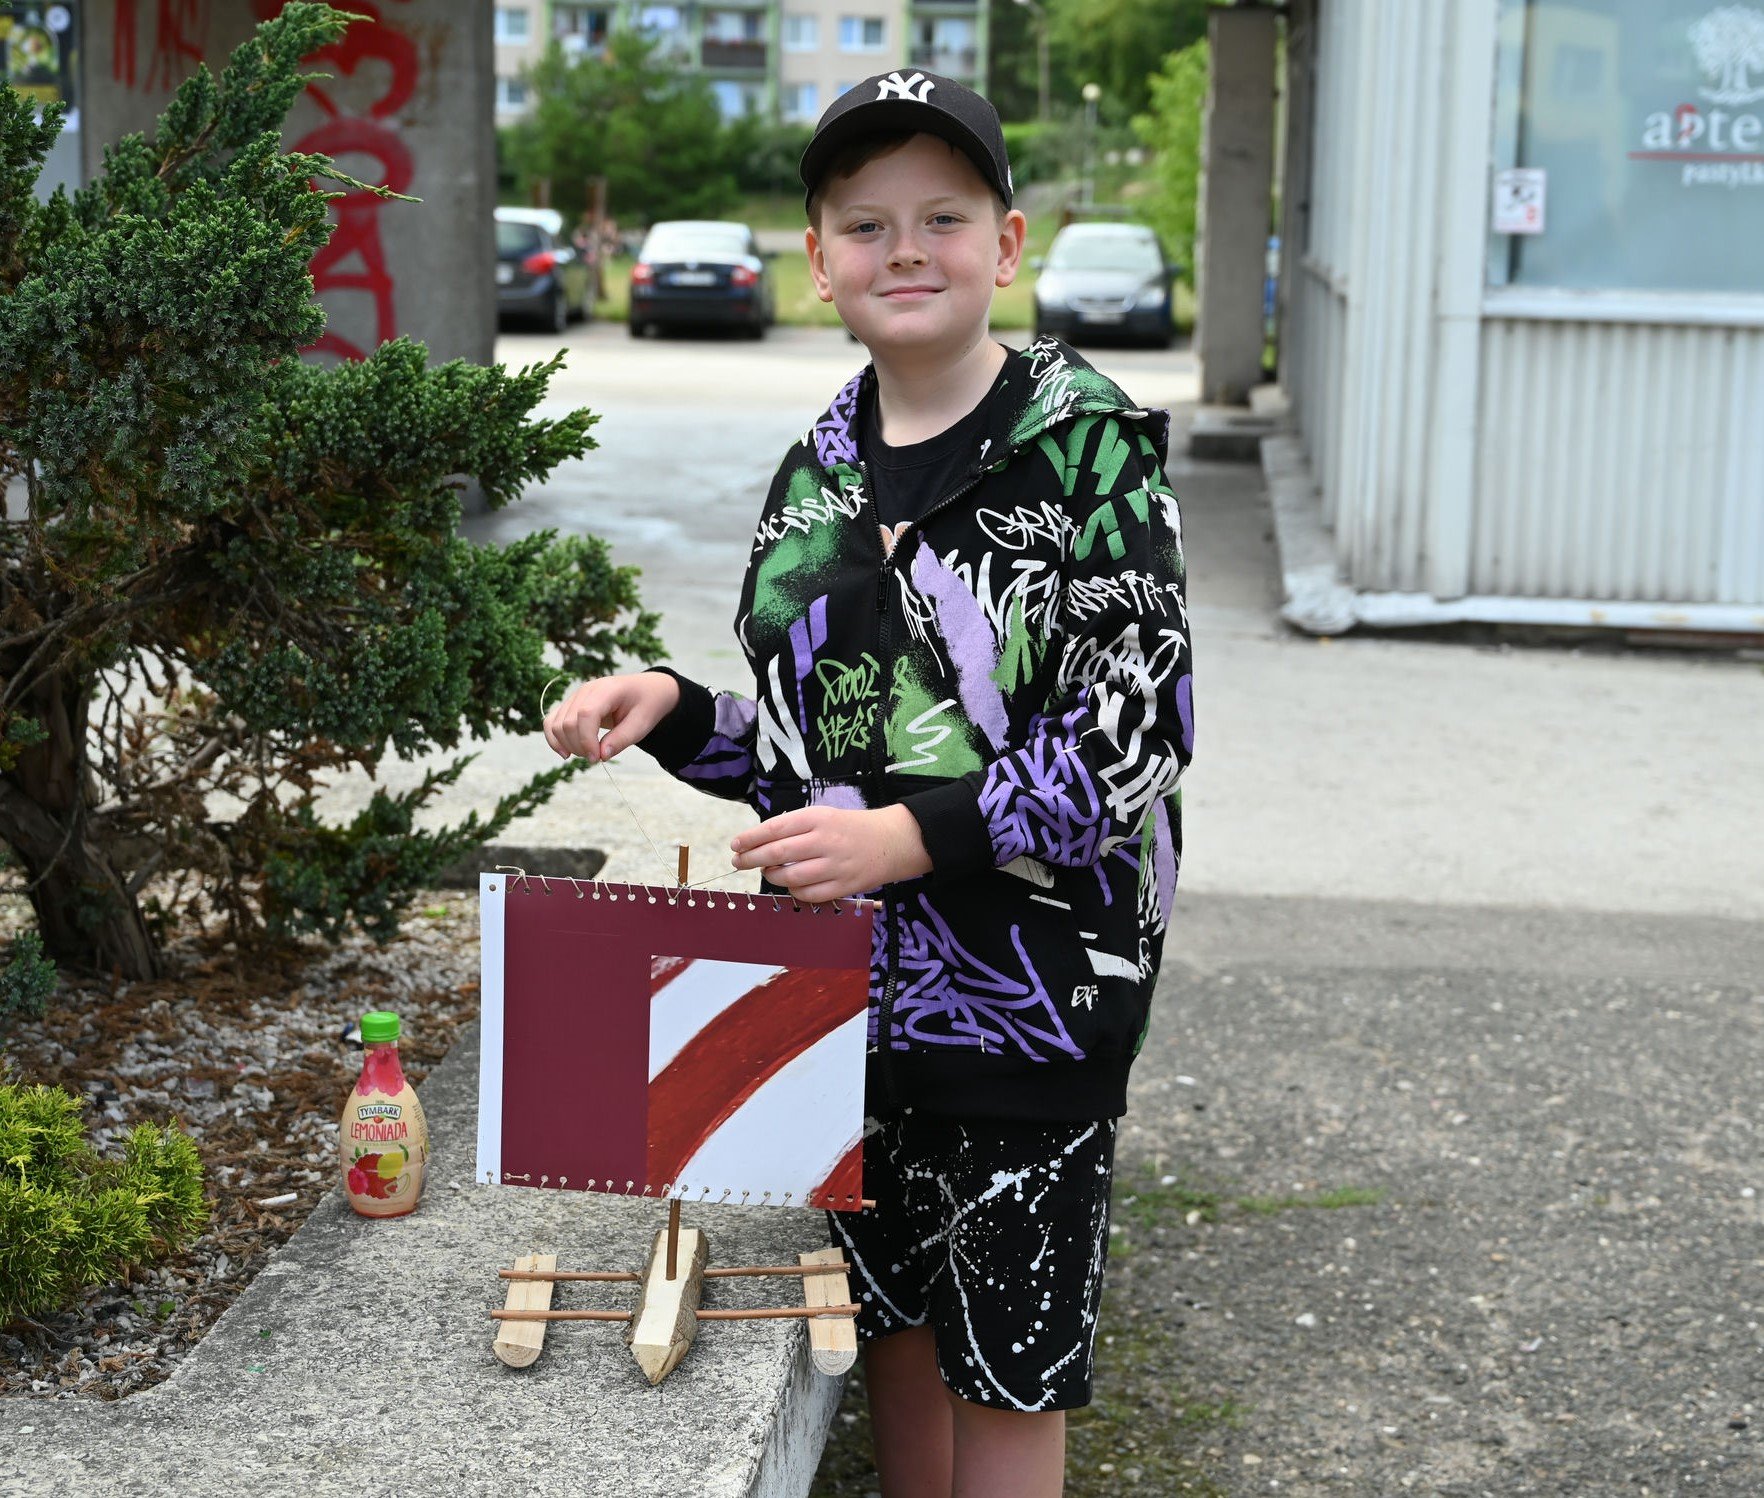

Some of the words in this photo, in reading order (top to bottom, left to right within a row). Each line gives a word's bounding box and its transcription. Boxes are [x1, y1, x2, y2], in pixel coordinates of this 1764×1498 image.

[876, 72, 935, 103] NY
[360, 1106, 398, 1117] TYMBARK
[350, 1121, 408, 1142] LEMONIADA
